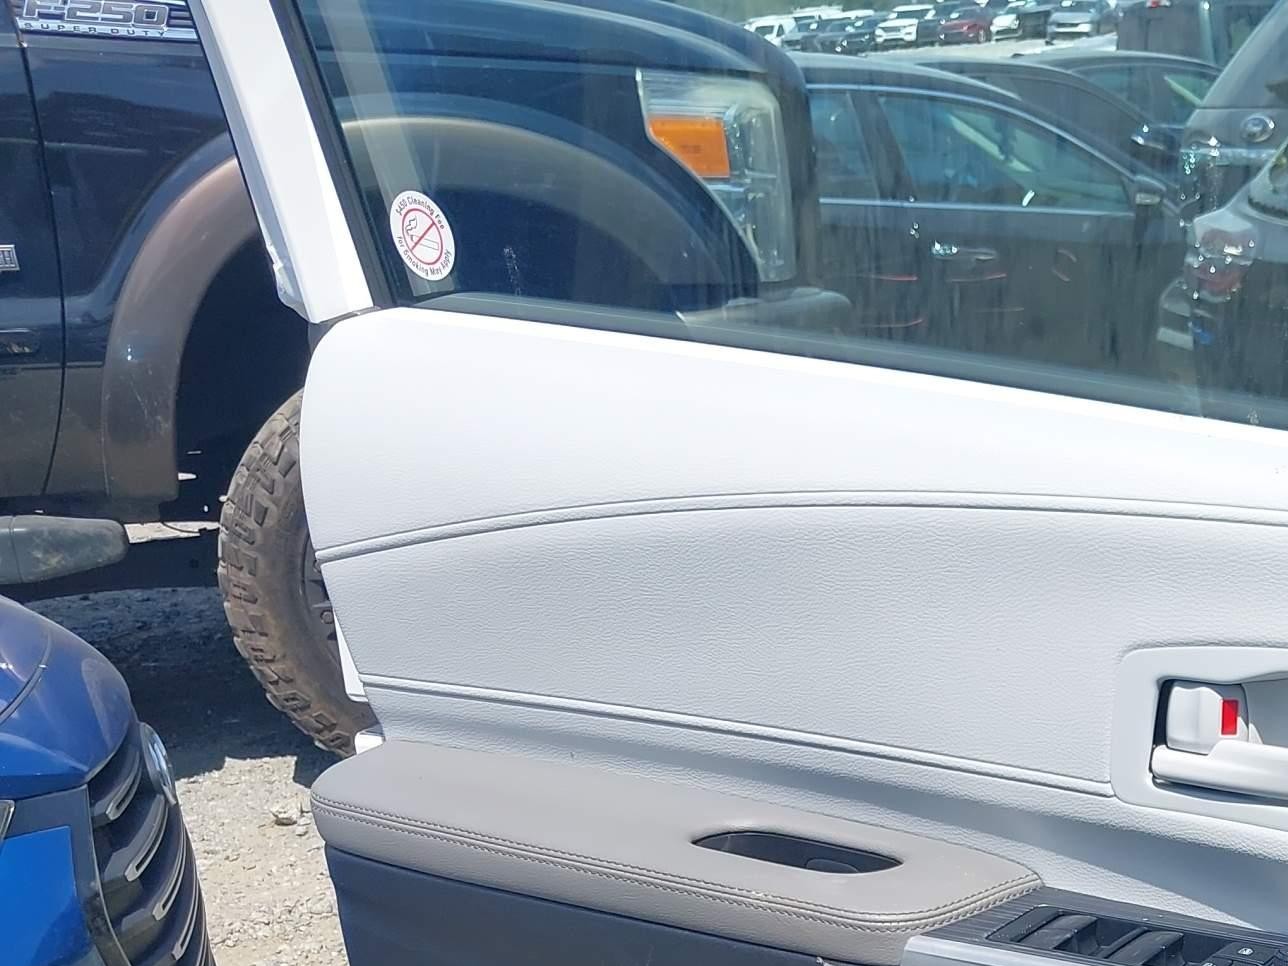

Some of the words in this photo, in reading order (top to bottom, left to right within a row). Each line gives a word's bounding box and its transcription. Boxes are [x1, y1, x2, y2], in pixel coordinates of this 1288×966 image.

[23, 0, 169, 28] F-250
[24, 22, 98, 33] SUPER
[110, 28, 166, 37] DUTY
[406, 196, 435, 216] Cleaning
[434, 214, 445, 230] Fee
[403, 249, 429, 278] Smoking
[429, 266, 443, 276] May
[440, 249, 453, 270] Apply
